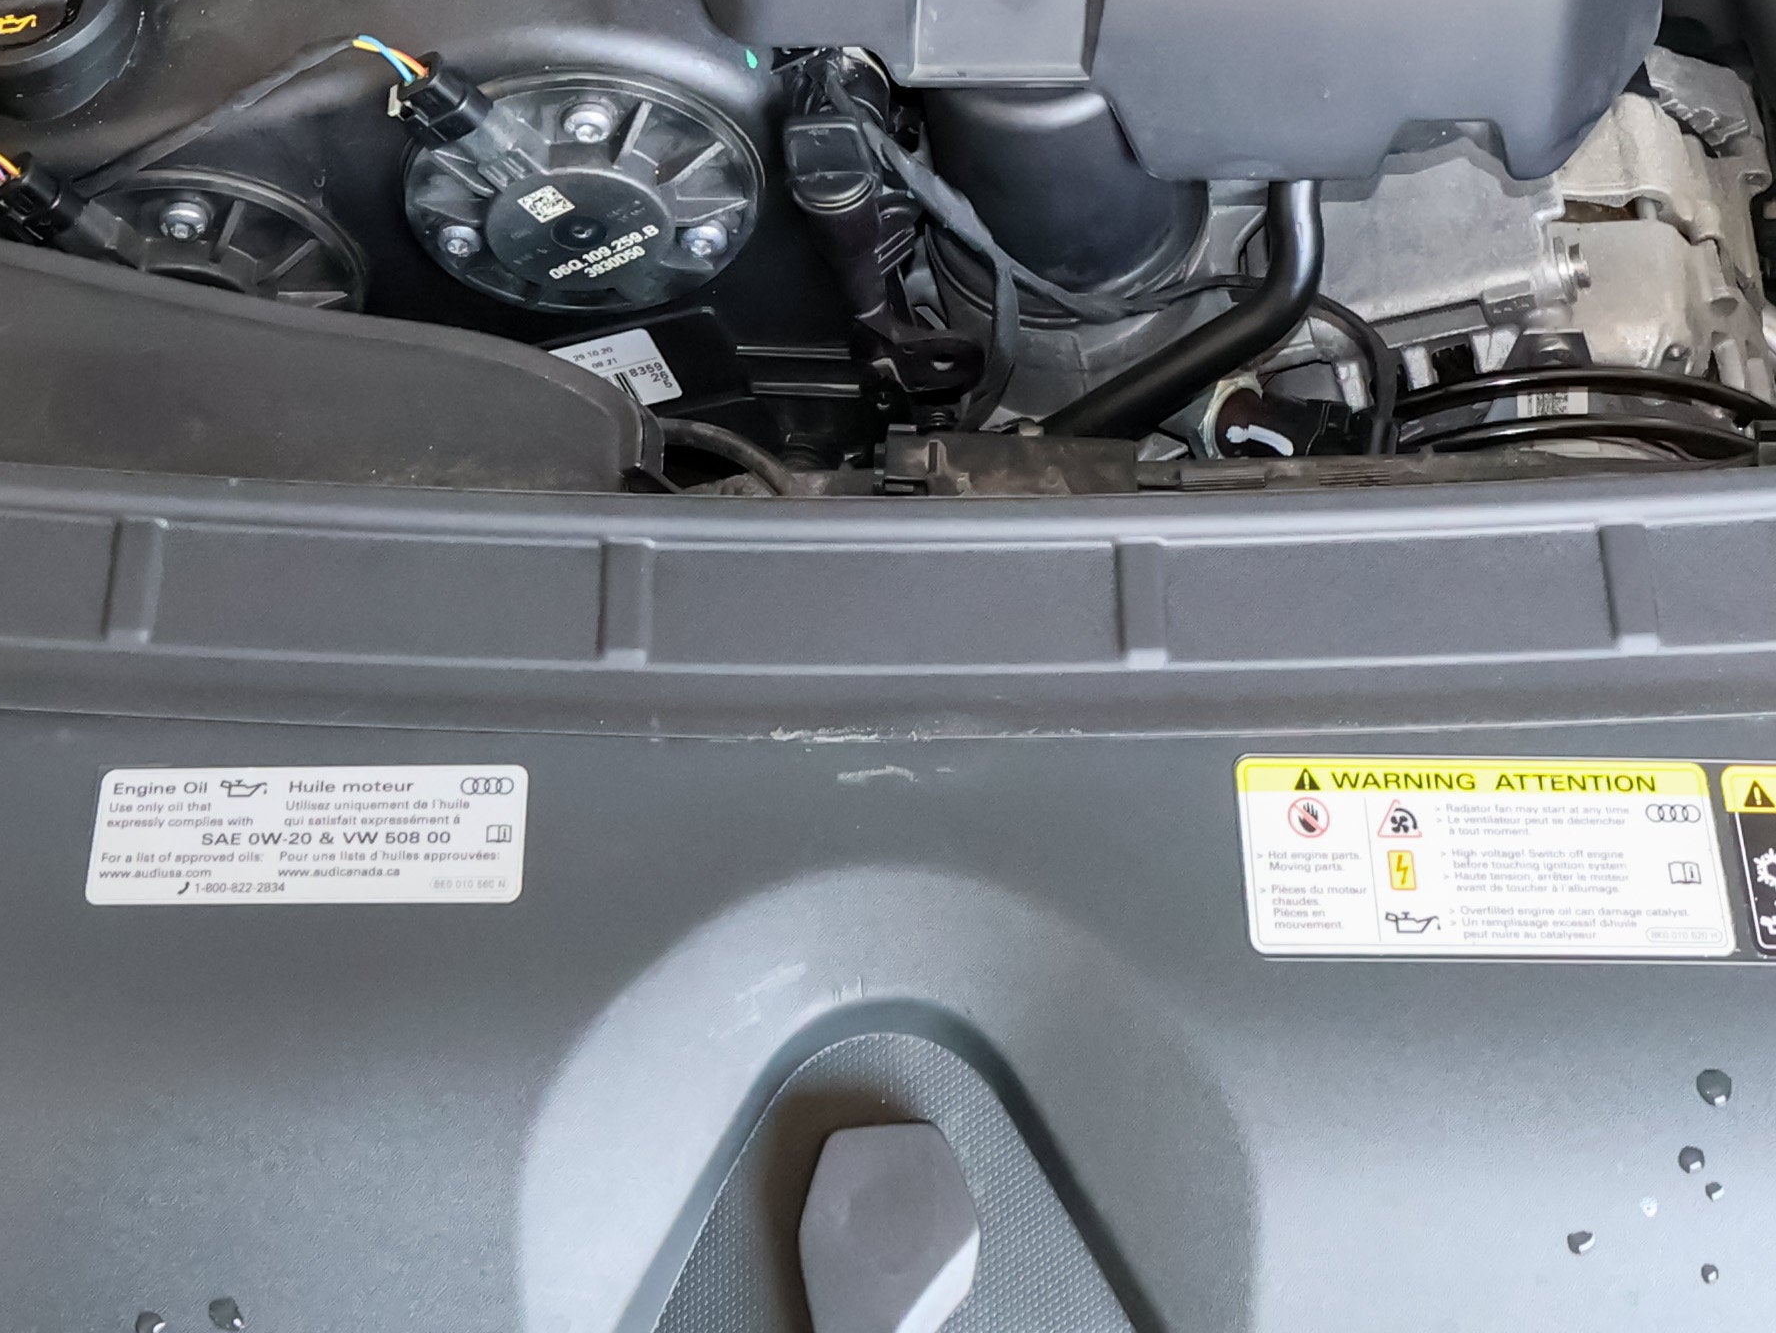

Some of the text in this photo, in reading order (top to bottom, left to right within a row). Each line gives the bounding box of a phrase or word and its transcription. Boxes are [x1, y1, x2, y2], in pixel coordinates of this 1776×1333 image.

[549, 224, 659, 279] 06Q.109.259.B
[584, 245, 645, 278] 3930D50
[629, 362, 663, 377] 8359
[289, 780, 414, 793] Huile moteur
[1332, 771, 1657, 793] WARNING ATTENTION
[113, 781, 208, 797] Engine Oil
[109, 801, 212, 814] Use only oil that
[286, 799, 330, 811] Utilisez
[334, 801, 410, 812] uniquement
[413, 799, 428, 810] de
[1495, 804, 1511, 813] fan
[1515, 806, 1538, 815] may
[1542, 806, 1565, 814] start
[1570, 806, 1579, 814] at
[1583, 807, 1601, 815] any
[107, 817, 254, 829] expressly complies with
[284, 816, 304, 827] qui
[308, 815, 357, 826] satisfait
[1447, 815, 1460, 824] Le
[1525, 817, 1548, 826] peut
[1459, 827, 1480, 835] tout
[201, 832, 451, 846] SAE 0W-20 & VW 508 00
[101, 852, 264, 864] For a list of approved oils:
[280, 851, 309, 861] Pour
[340, 851, 366, 861] liste
[1268, 851, 1287, 859] Hot
[1291, 852, 1328, 861] engine
[1569, 849, 1583, 858] off
[1587, 851, 1624, 860] engine
[1269, 861, 1311, 872] Moving
[1492, 861, 1540, 871] touching
[1543, 861, 1585, 871] ignition
[99, 868, 212, 878] www.audiusa.com
[278, 867, 400, 877] www.audicanada.ca
[1310, 886, 1323, 894] du
[1327, 886, 1367, 894] moteur
[1490, 884, 1503, 892] de
[1312, 909, 1325, 917] en
[1517, 908, 1555, 917] engine
[1558, 907, 1572, 916] oil
[1575, 908, 1594, 916] can
[1598, 907, 1643, 918] damage
[1461, 918, 1478, 927] Un
